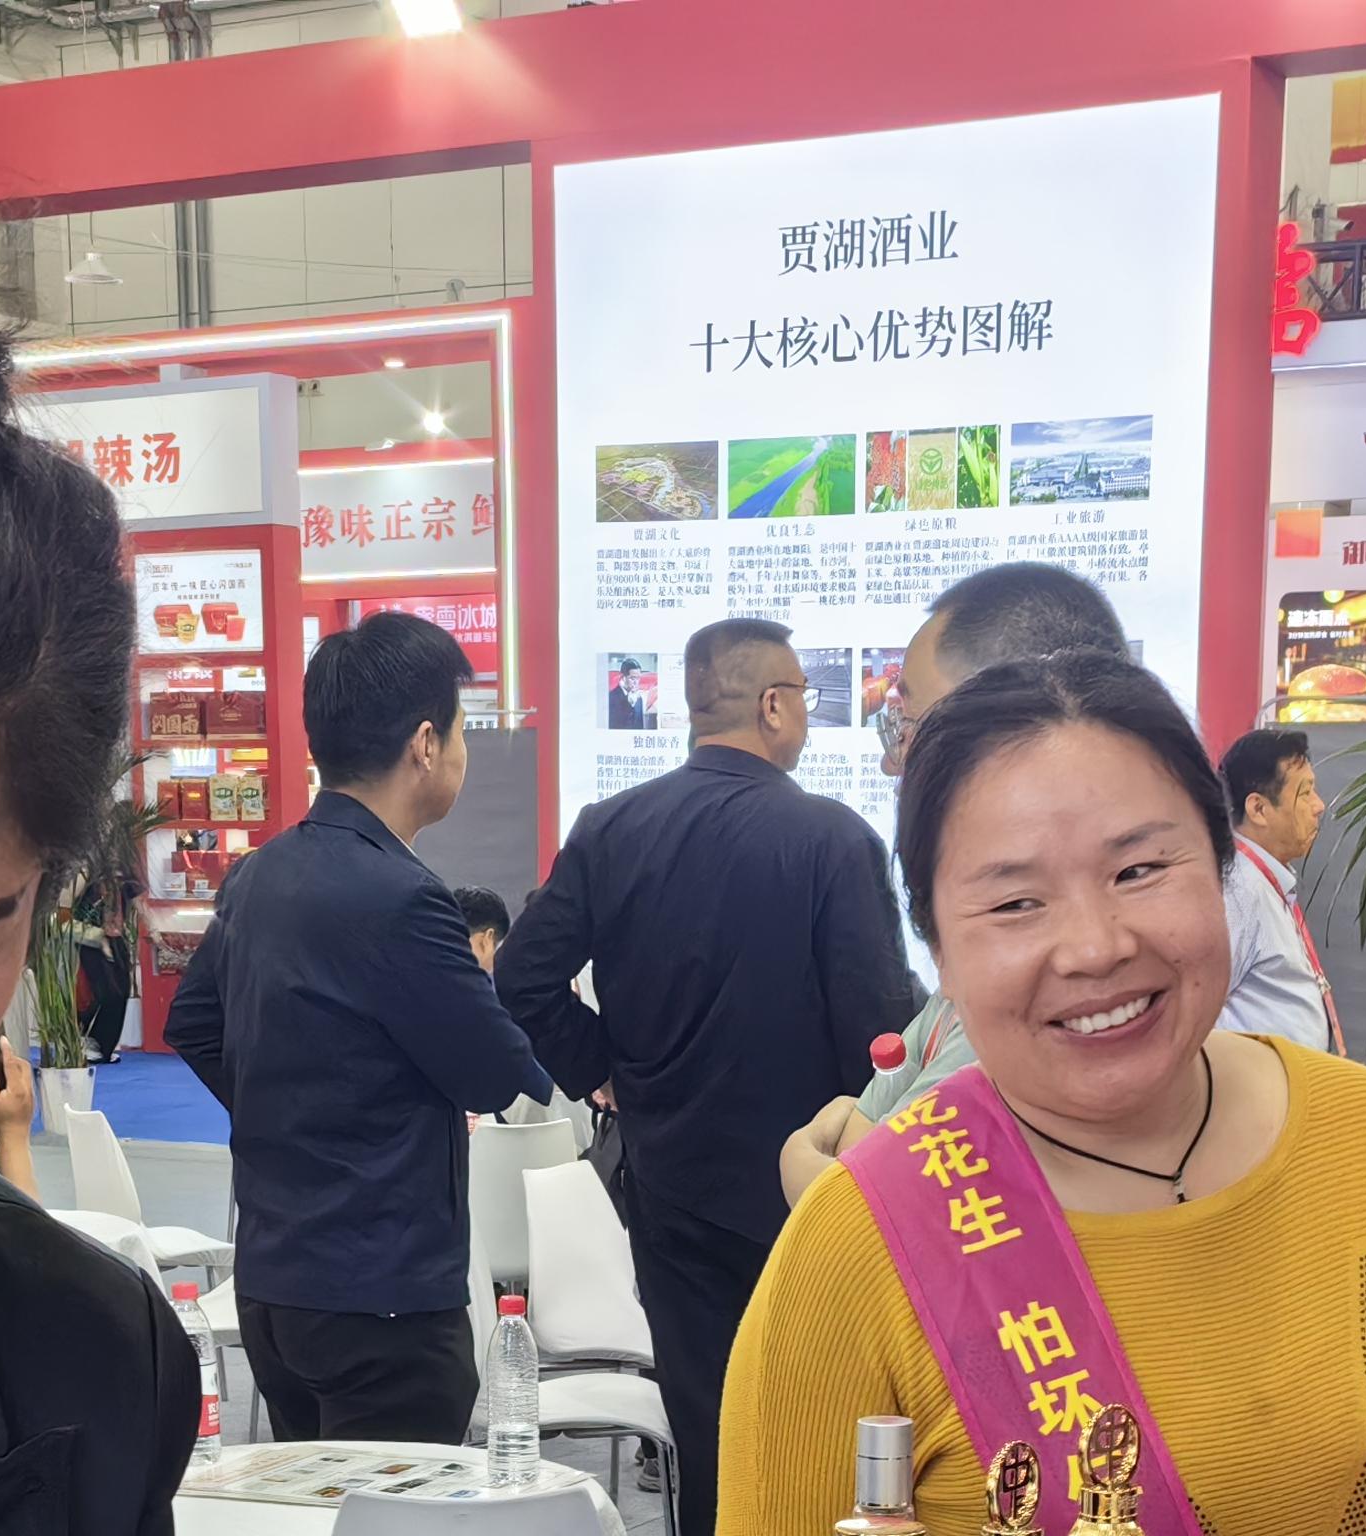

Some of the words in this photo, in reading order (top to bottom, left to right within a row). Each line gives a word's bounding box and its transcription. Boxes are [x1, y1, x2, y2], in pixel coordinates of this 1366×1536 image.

[778, 210, 959, 276] 贾湖酒业
[689, 299, 1053, 374] 十大核心优势图解
